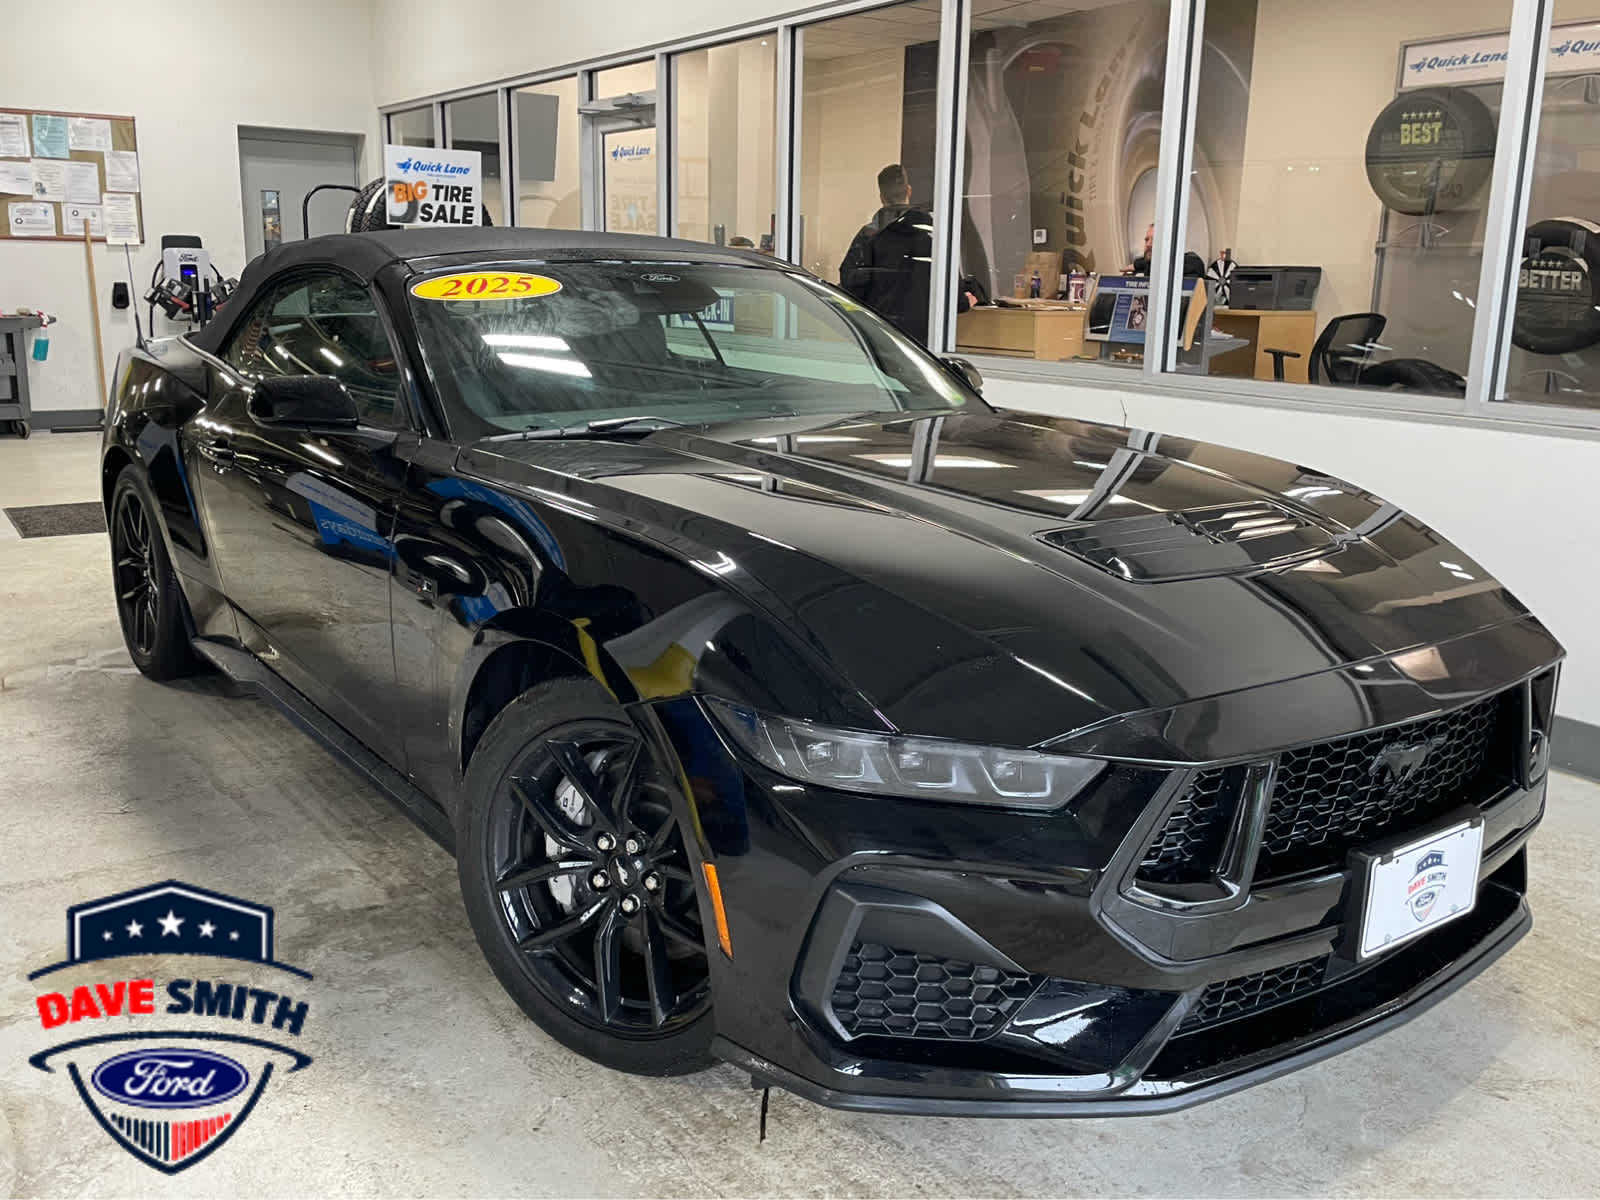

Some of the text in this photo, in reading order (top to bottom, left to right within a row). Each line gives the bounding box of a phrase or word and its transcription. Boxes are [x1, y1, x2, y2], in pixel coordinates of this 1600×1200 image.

[1427, 53, 1470, 69] Quick
[1400, 122, 1442, 145] BEST
[620, 146, 650, 158] Quick Lane
[413, 160, 471, 175] Quick Lane
[394, 180, 473, 203] BIG TIRE
[420, 203, 475, 224] SALE
[1061, 136, 1096, 273] Quick
[441, 276, 533, 297] 2025
[1518, 268, 1582, 290] BETTER
